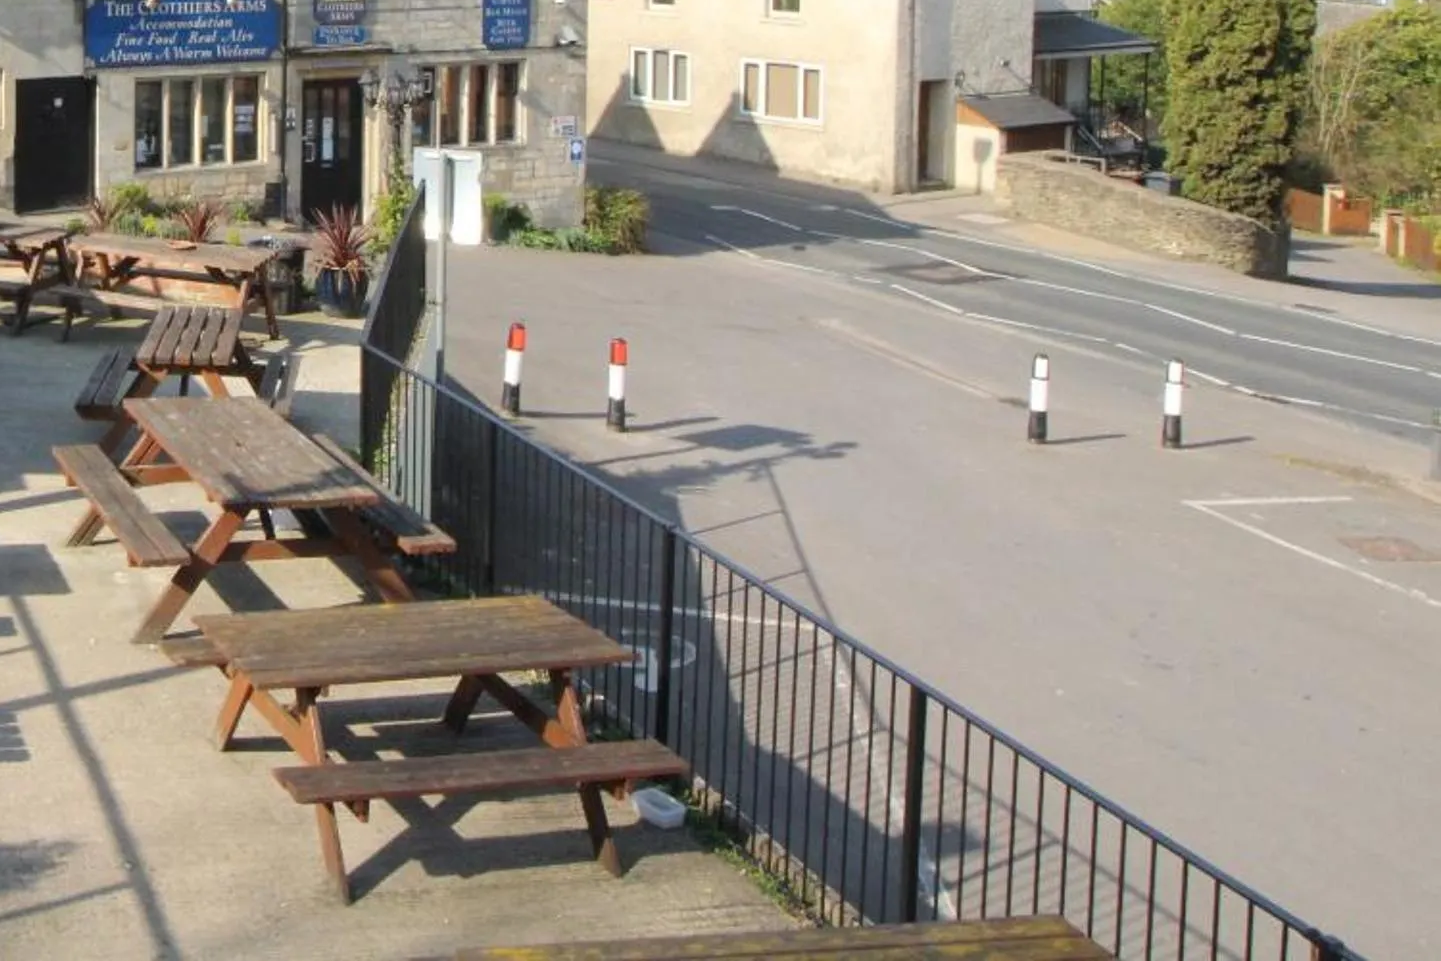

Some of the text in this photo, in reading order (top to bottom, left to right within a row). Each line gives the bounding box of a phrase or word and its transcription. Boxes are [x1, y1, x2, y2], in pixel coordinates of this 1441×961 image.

[104, 0, 134, 17] THE
[130, 16, 234, 31] Accommodation
[115, 28, 254, 48] Fine Food Real Ales
[100, 48, 153, 64] Always
[172, 45, 213, 60] Warm
[216, 43, 267, 59] Welcome
